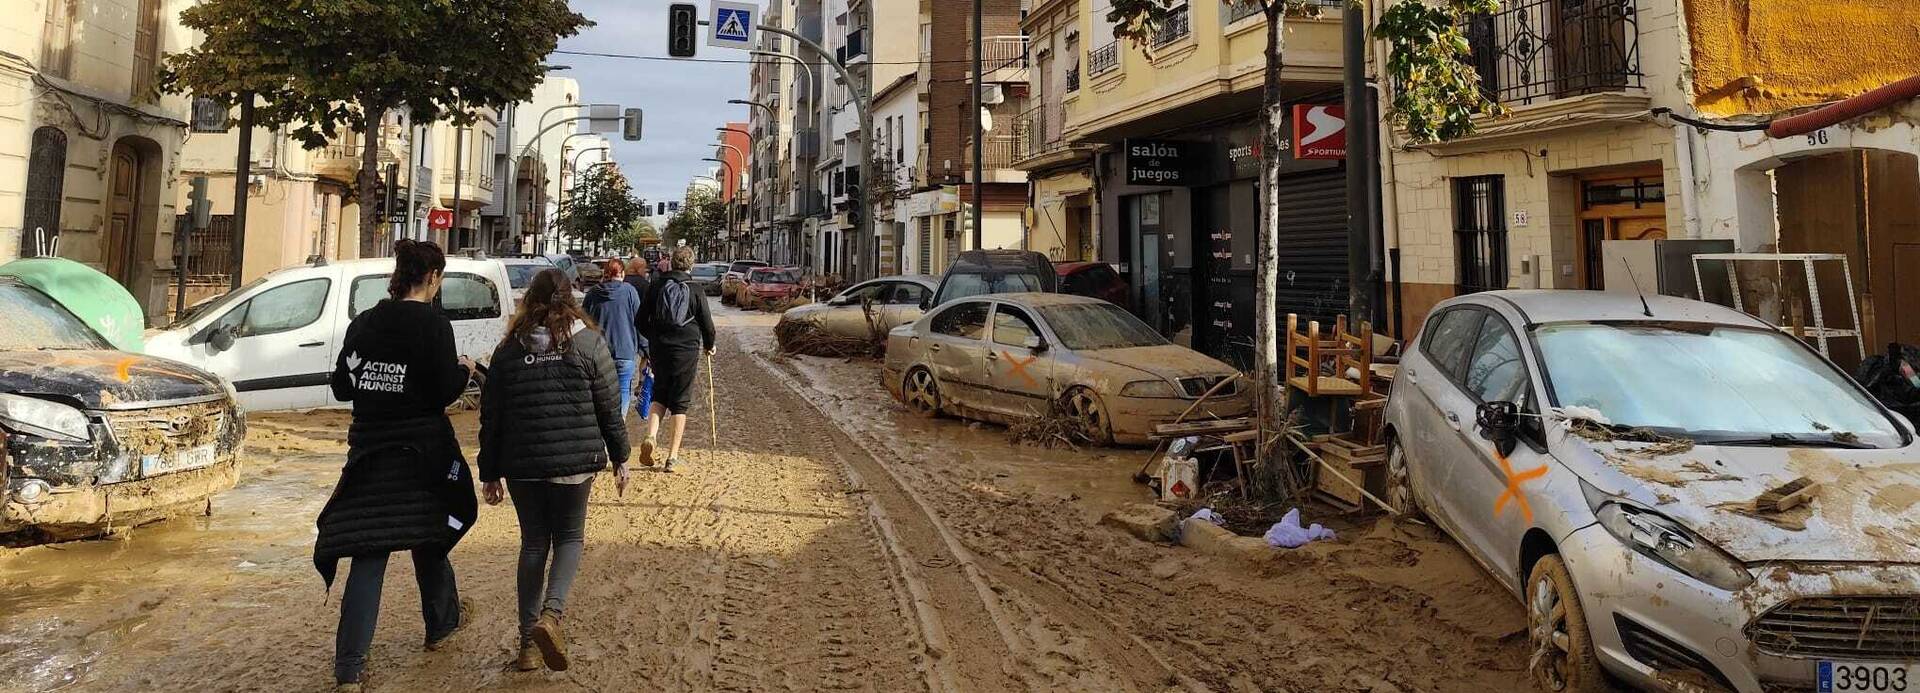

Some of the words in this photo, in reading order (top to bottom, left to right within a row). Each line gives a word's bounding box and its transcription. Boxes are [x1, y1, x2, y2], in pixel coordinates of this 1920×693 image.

[1131, 143, 1179, 158] salón
[1228, 143, 1253, 162] sports
[1304, 148, 1347, 157] SPORTIUM
[1148, 158, 1161, 167] de
[1131, 166, 1180, 182] juegos
[1514, 212, 1526, 225] 58
[362, 360, 408, 375] ACTION
[360, 370, 406, 384] AGAINST
[358, 379, 405, 393] HUNGER
[1822, 680, 1830, 689] E
[1835, 665, 1908, 692] 3903
